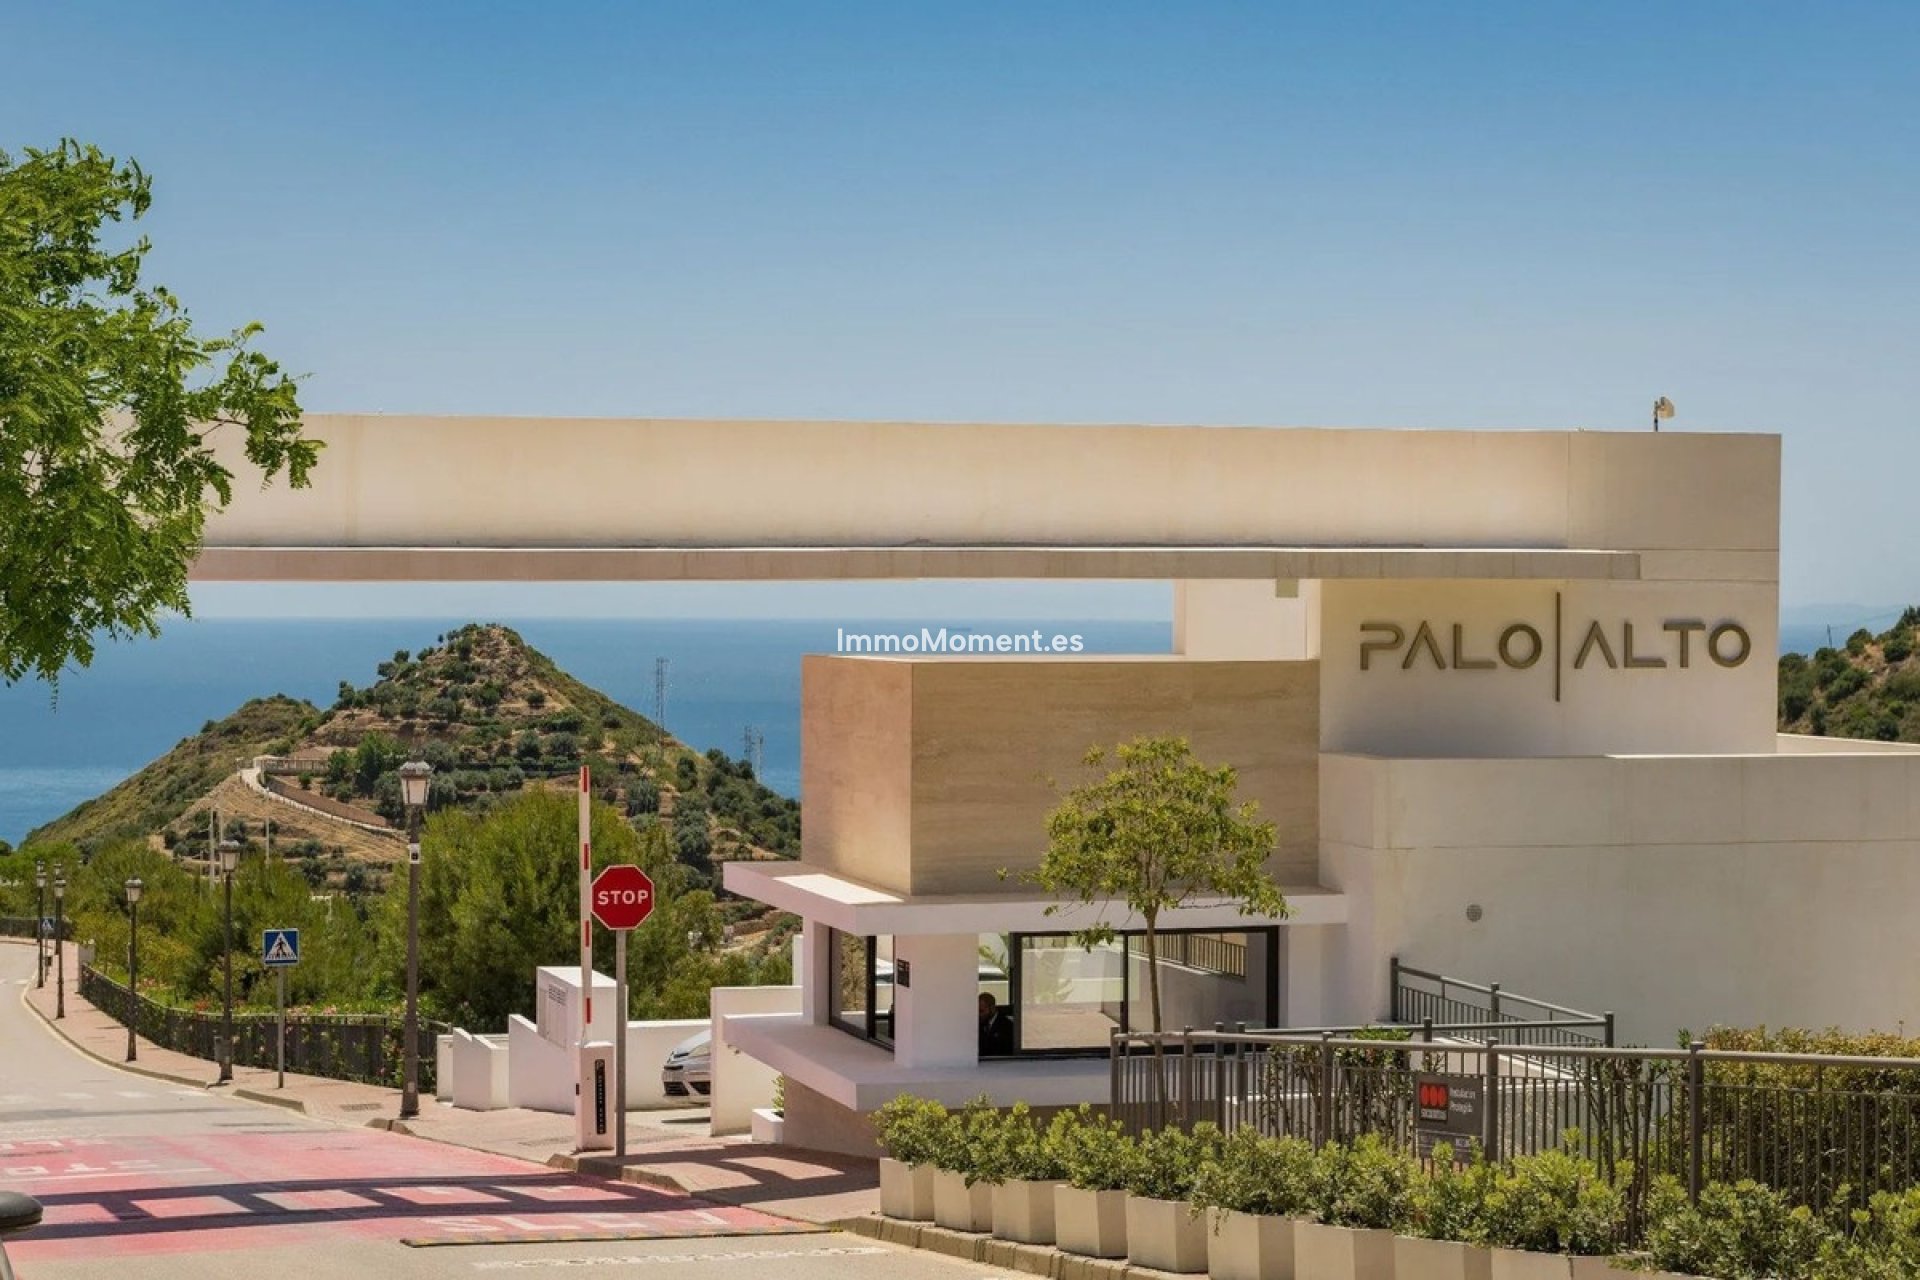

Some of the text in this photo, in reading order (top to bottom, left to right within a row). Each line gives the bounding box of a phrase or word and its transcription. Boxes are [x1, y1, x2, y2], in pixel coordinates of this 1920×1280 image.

[1359, 619, 1751, 670] PALO ALTO
[597, 890, 649, 905] STOP
